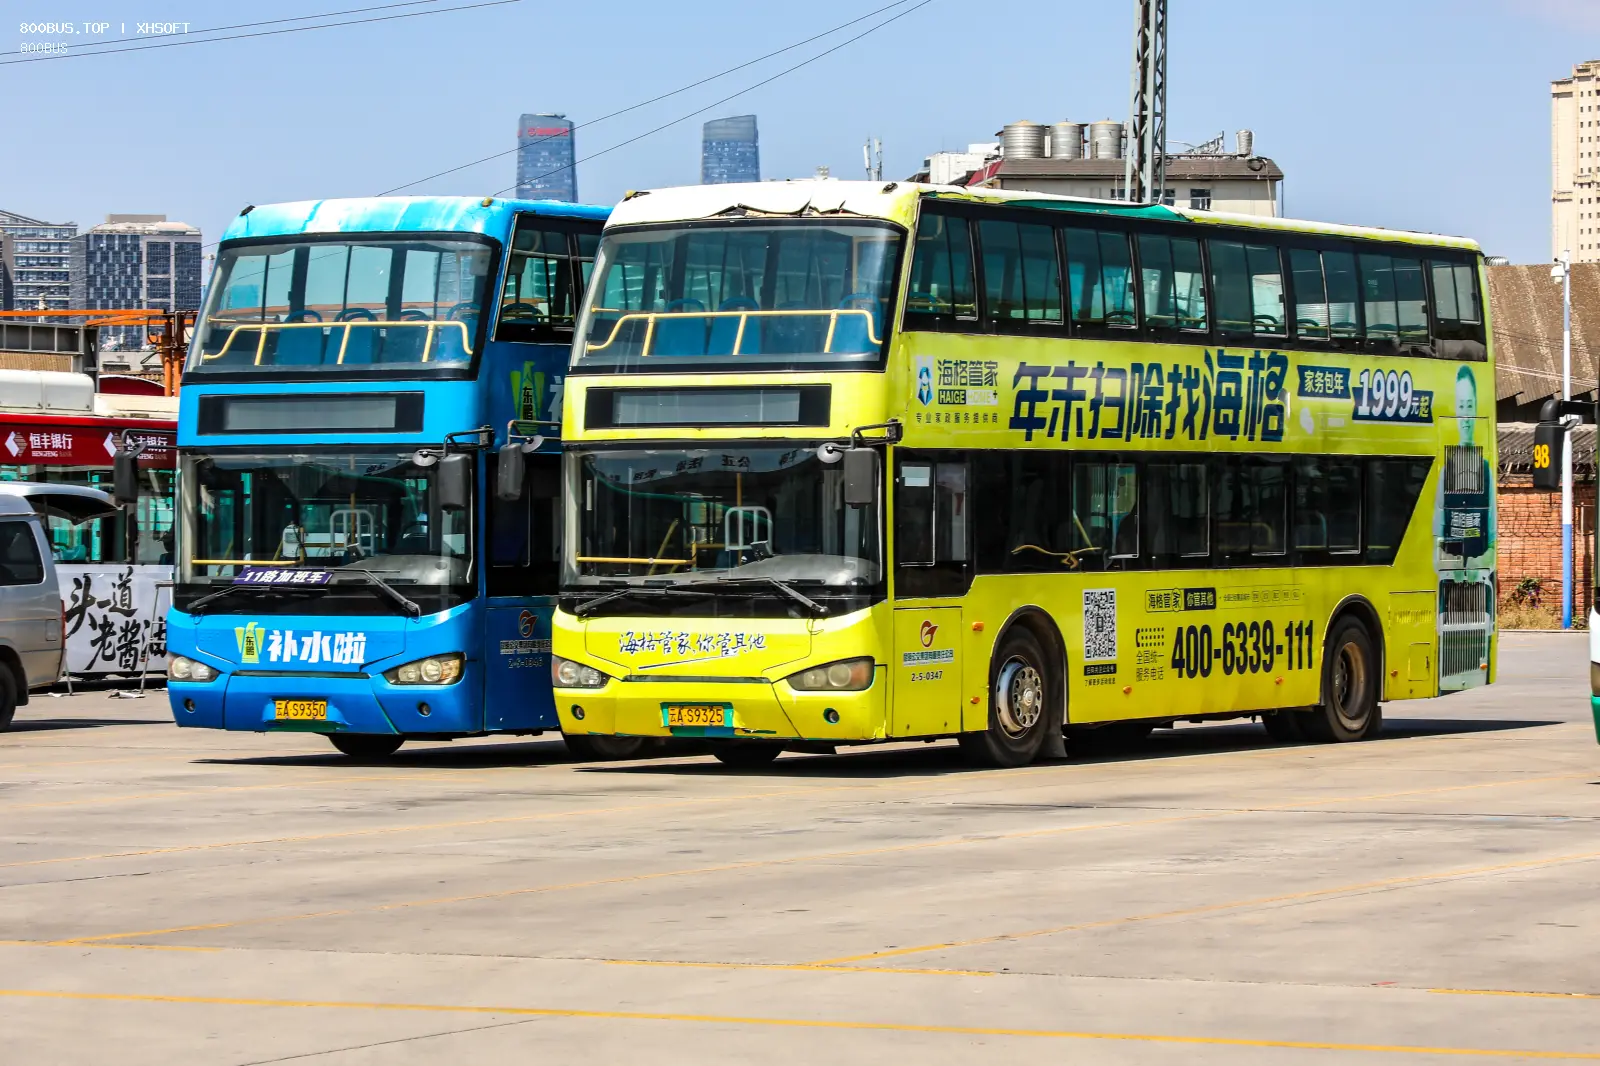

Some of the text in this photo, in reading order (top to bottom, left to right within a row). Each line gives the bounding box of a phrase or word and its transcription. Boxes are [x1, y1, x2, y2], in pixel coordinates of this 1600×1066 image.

[937, 359, 998, 387] 海格管家
[1303, 370, 1344, 395] 家务包年
[939, 390, 966, 404] HAIGE
[1009, 348, 1289, 443] 年末扫除找海格
[29, 432, 73, 450] 恒丰银行
[1534, 444, 1550, 469] 98
[243, 570, 326, 584] 11路加班车
[267, 629, 367, 665] 补水啦
[1136, 650, 1165, 665] 全国统一
[1171, 619, 1314, 679] 400-6339-111
[911, 670, 943, 682] 2-5-0347
[1136, 666, 1165, 682] 服务电话
